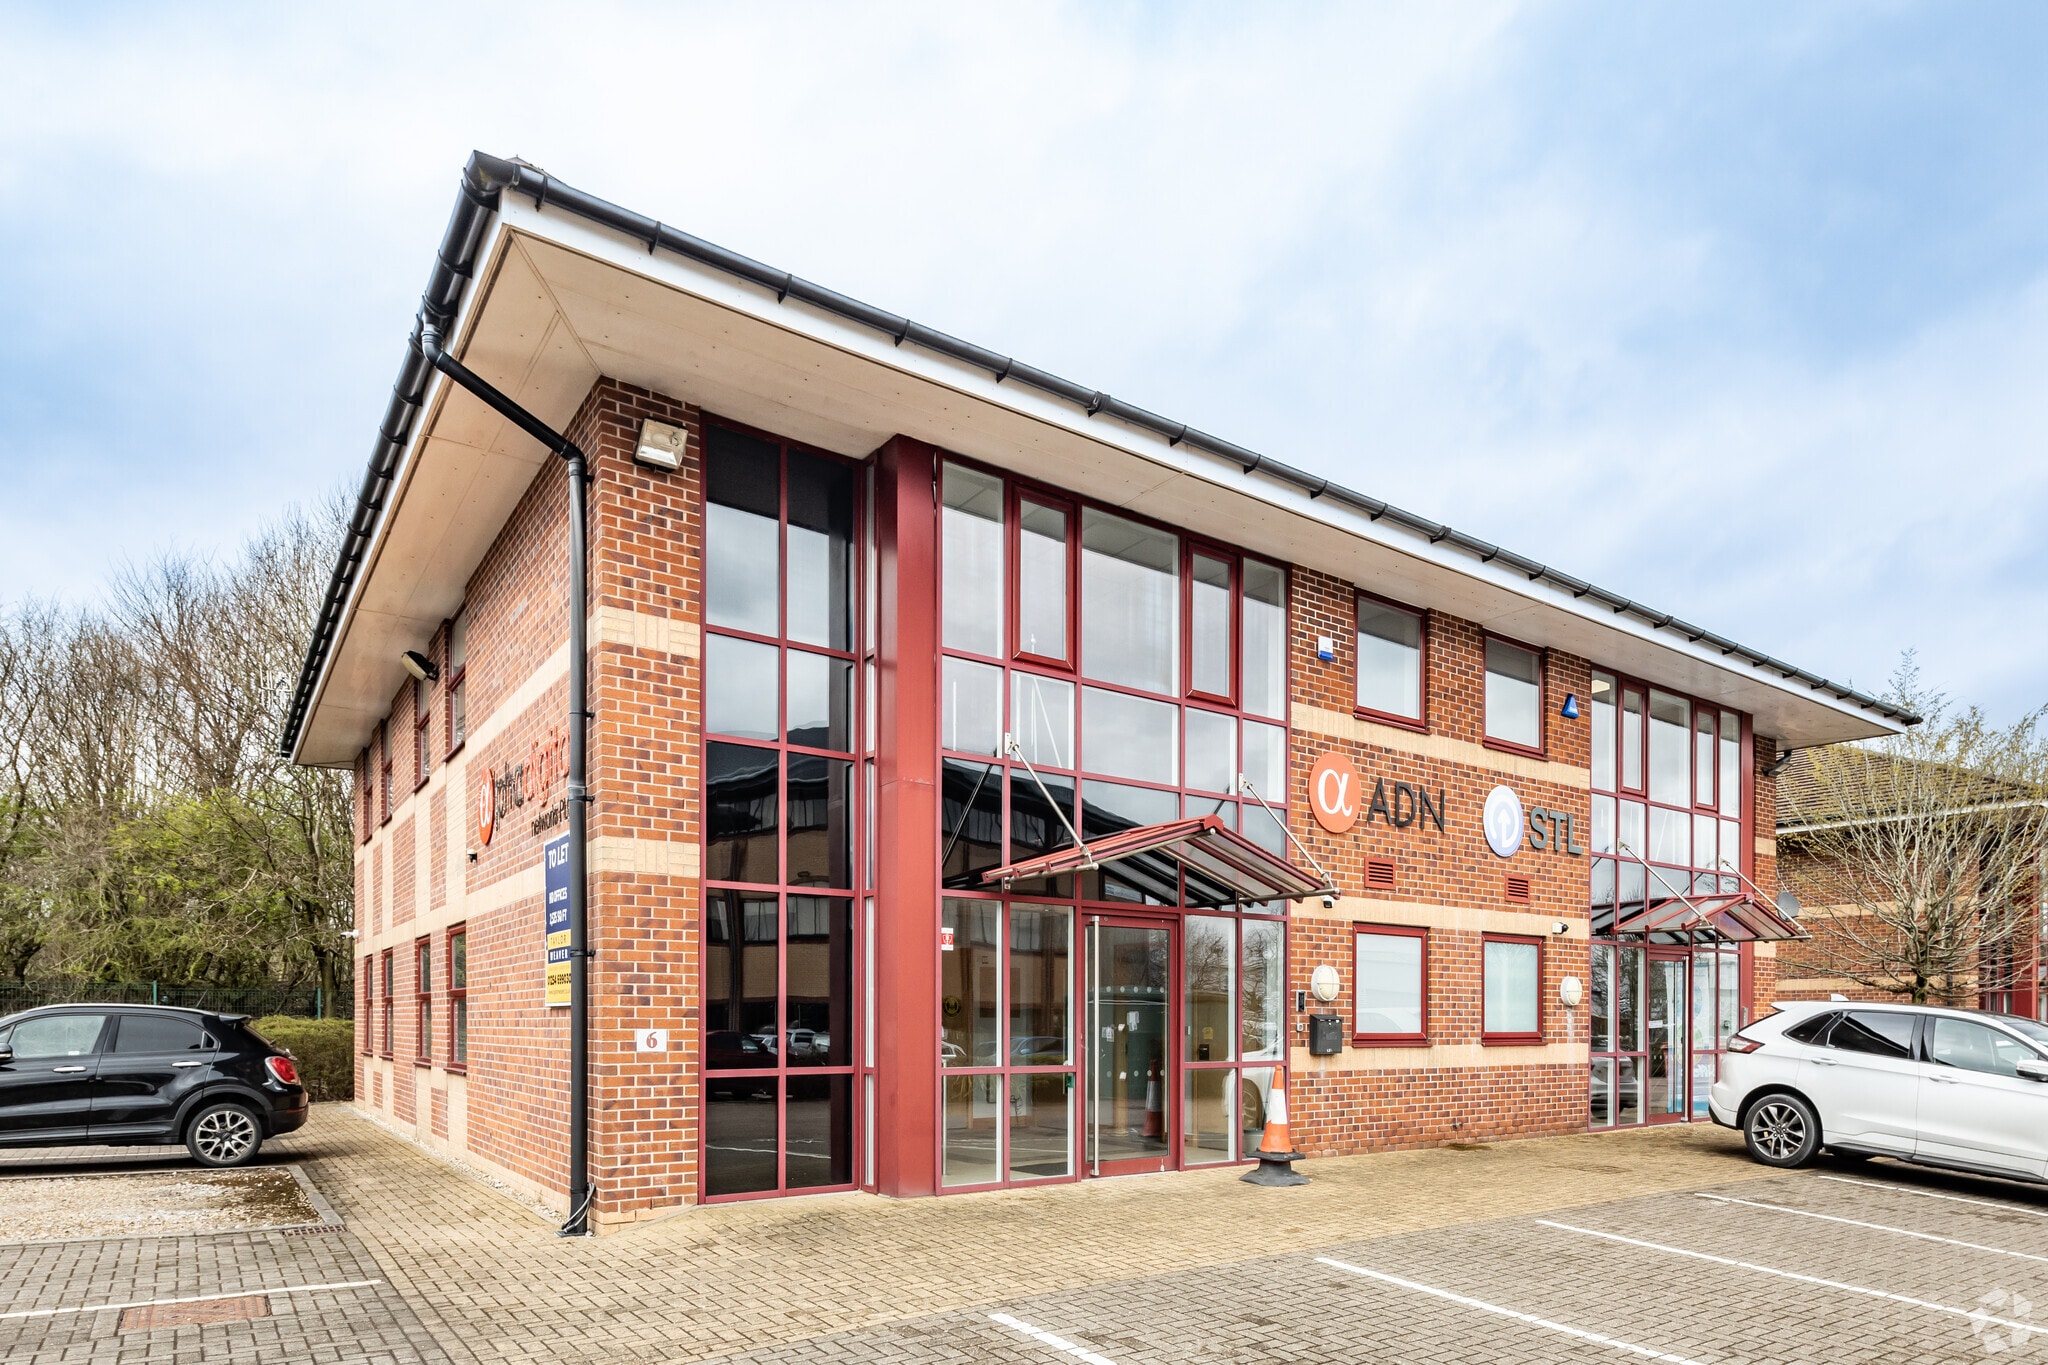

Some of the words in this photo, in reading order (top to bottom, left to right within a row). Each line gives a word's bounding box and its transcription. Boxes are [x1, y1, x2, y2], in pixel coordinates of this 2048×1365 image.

[1366, 777, 1445, 834] ADN
[1529, 807, 1583, 855] STL
[548, 848, 556, 869] TO
[557, 842, 569, 866] LET
[550, 934, 567, 945] TAYLOR
[550, 948, 568, 961] WEAVER
[646, 1031, 658, 1048] 6
